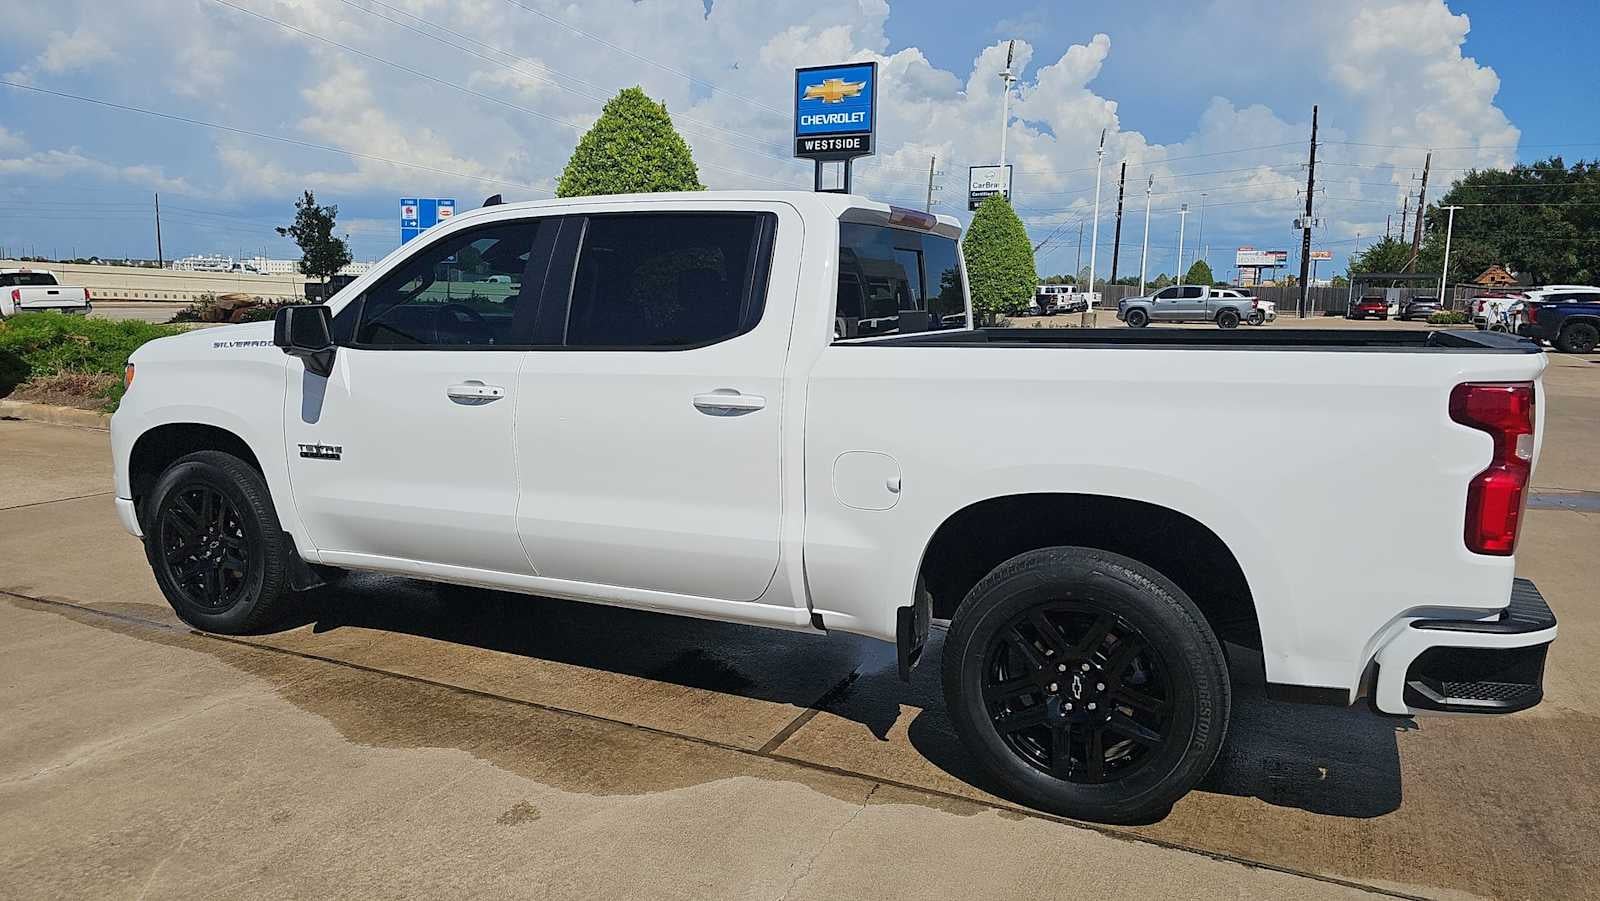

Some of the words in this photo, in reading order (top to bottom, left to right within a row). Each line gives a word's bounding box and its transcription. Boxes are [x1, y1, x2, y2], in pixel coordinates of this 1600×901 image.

[801, 112, 865, 125] CHEVROLET
[805, 138, 860, 150] WESTSIDE
[972, 181, 1007, 189] CarBra
